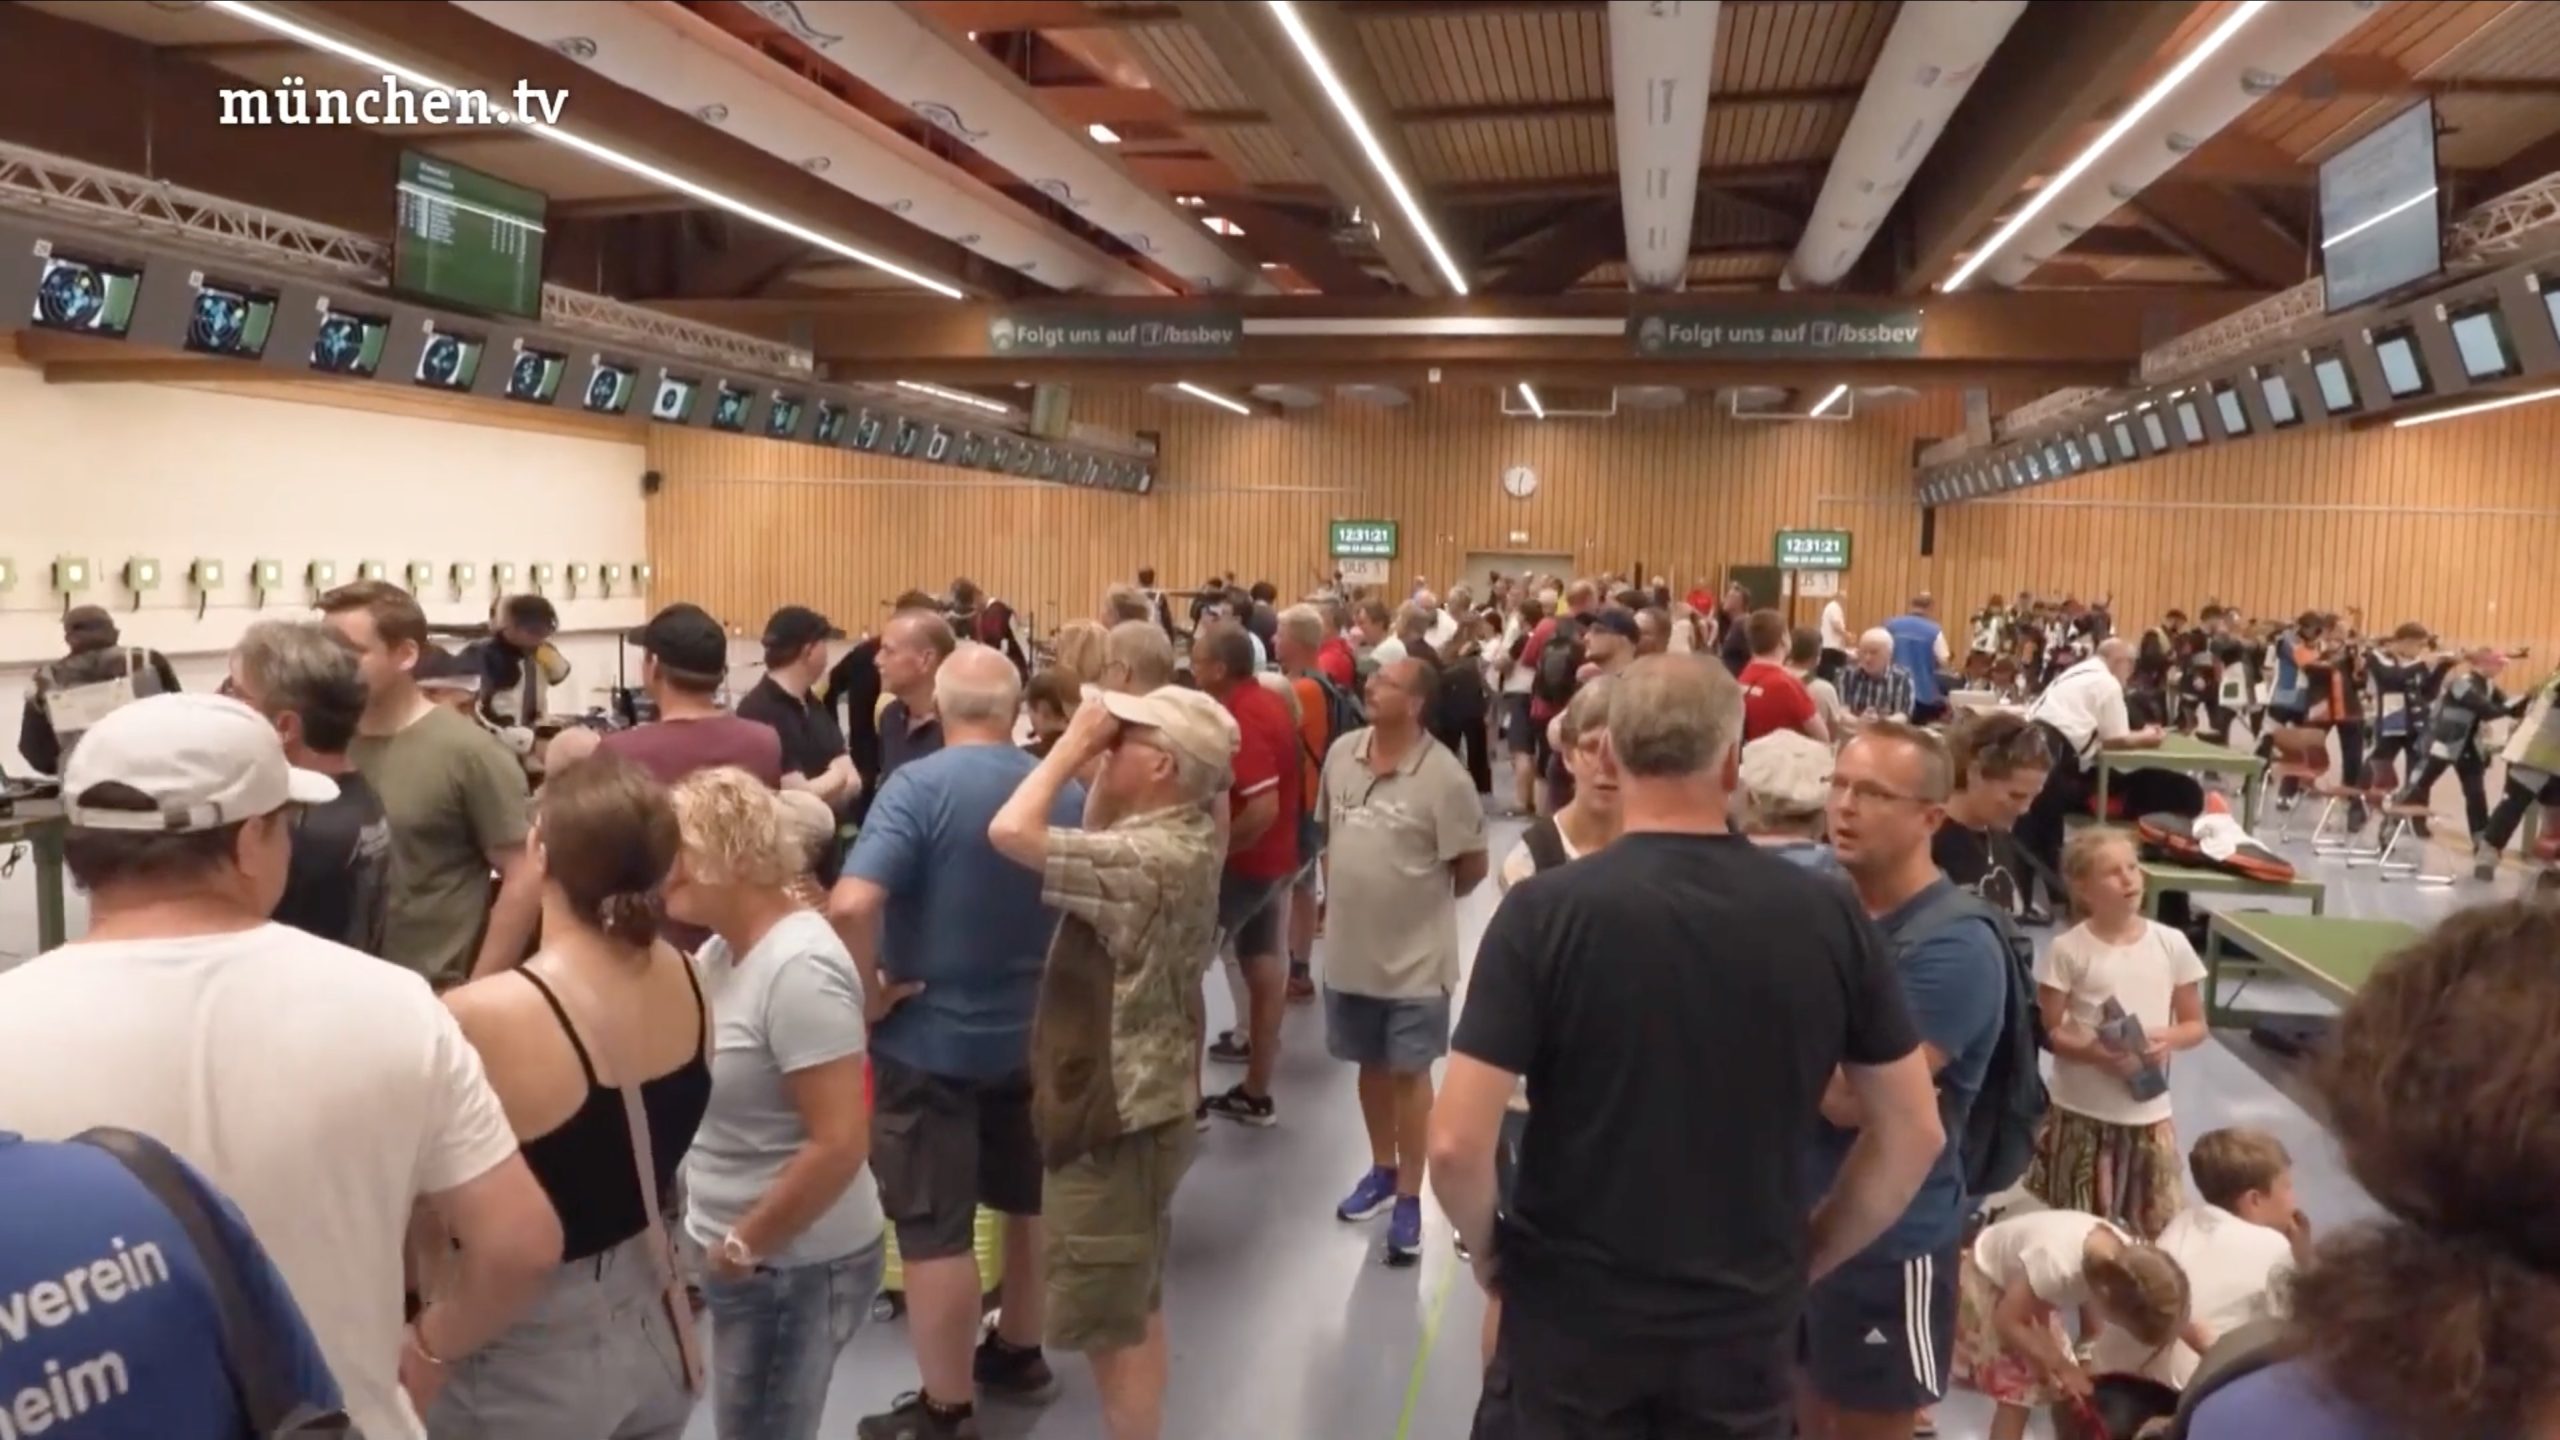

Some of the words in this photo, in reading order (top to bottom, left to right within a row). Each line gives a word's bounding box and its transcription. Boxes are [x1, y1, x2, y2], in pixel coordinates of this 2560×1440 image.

[1017, 325, 1065, 348] Folgt
[1069, 328, 1100, 343] uns
[1106, 324, 1138, 343] auf
[1668, 323, 1722, 348] Folgt
[1728, 328, 1765, 343] uns
[1771, 323, 1806, 343] auf
[1339, 527, 1388, 542] 12:31:21
[1786, 537, 1840, 553] 12:31:21
